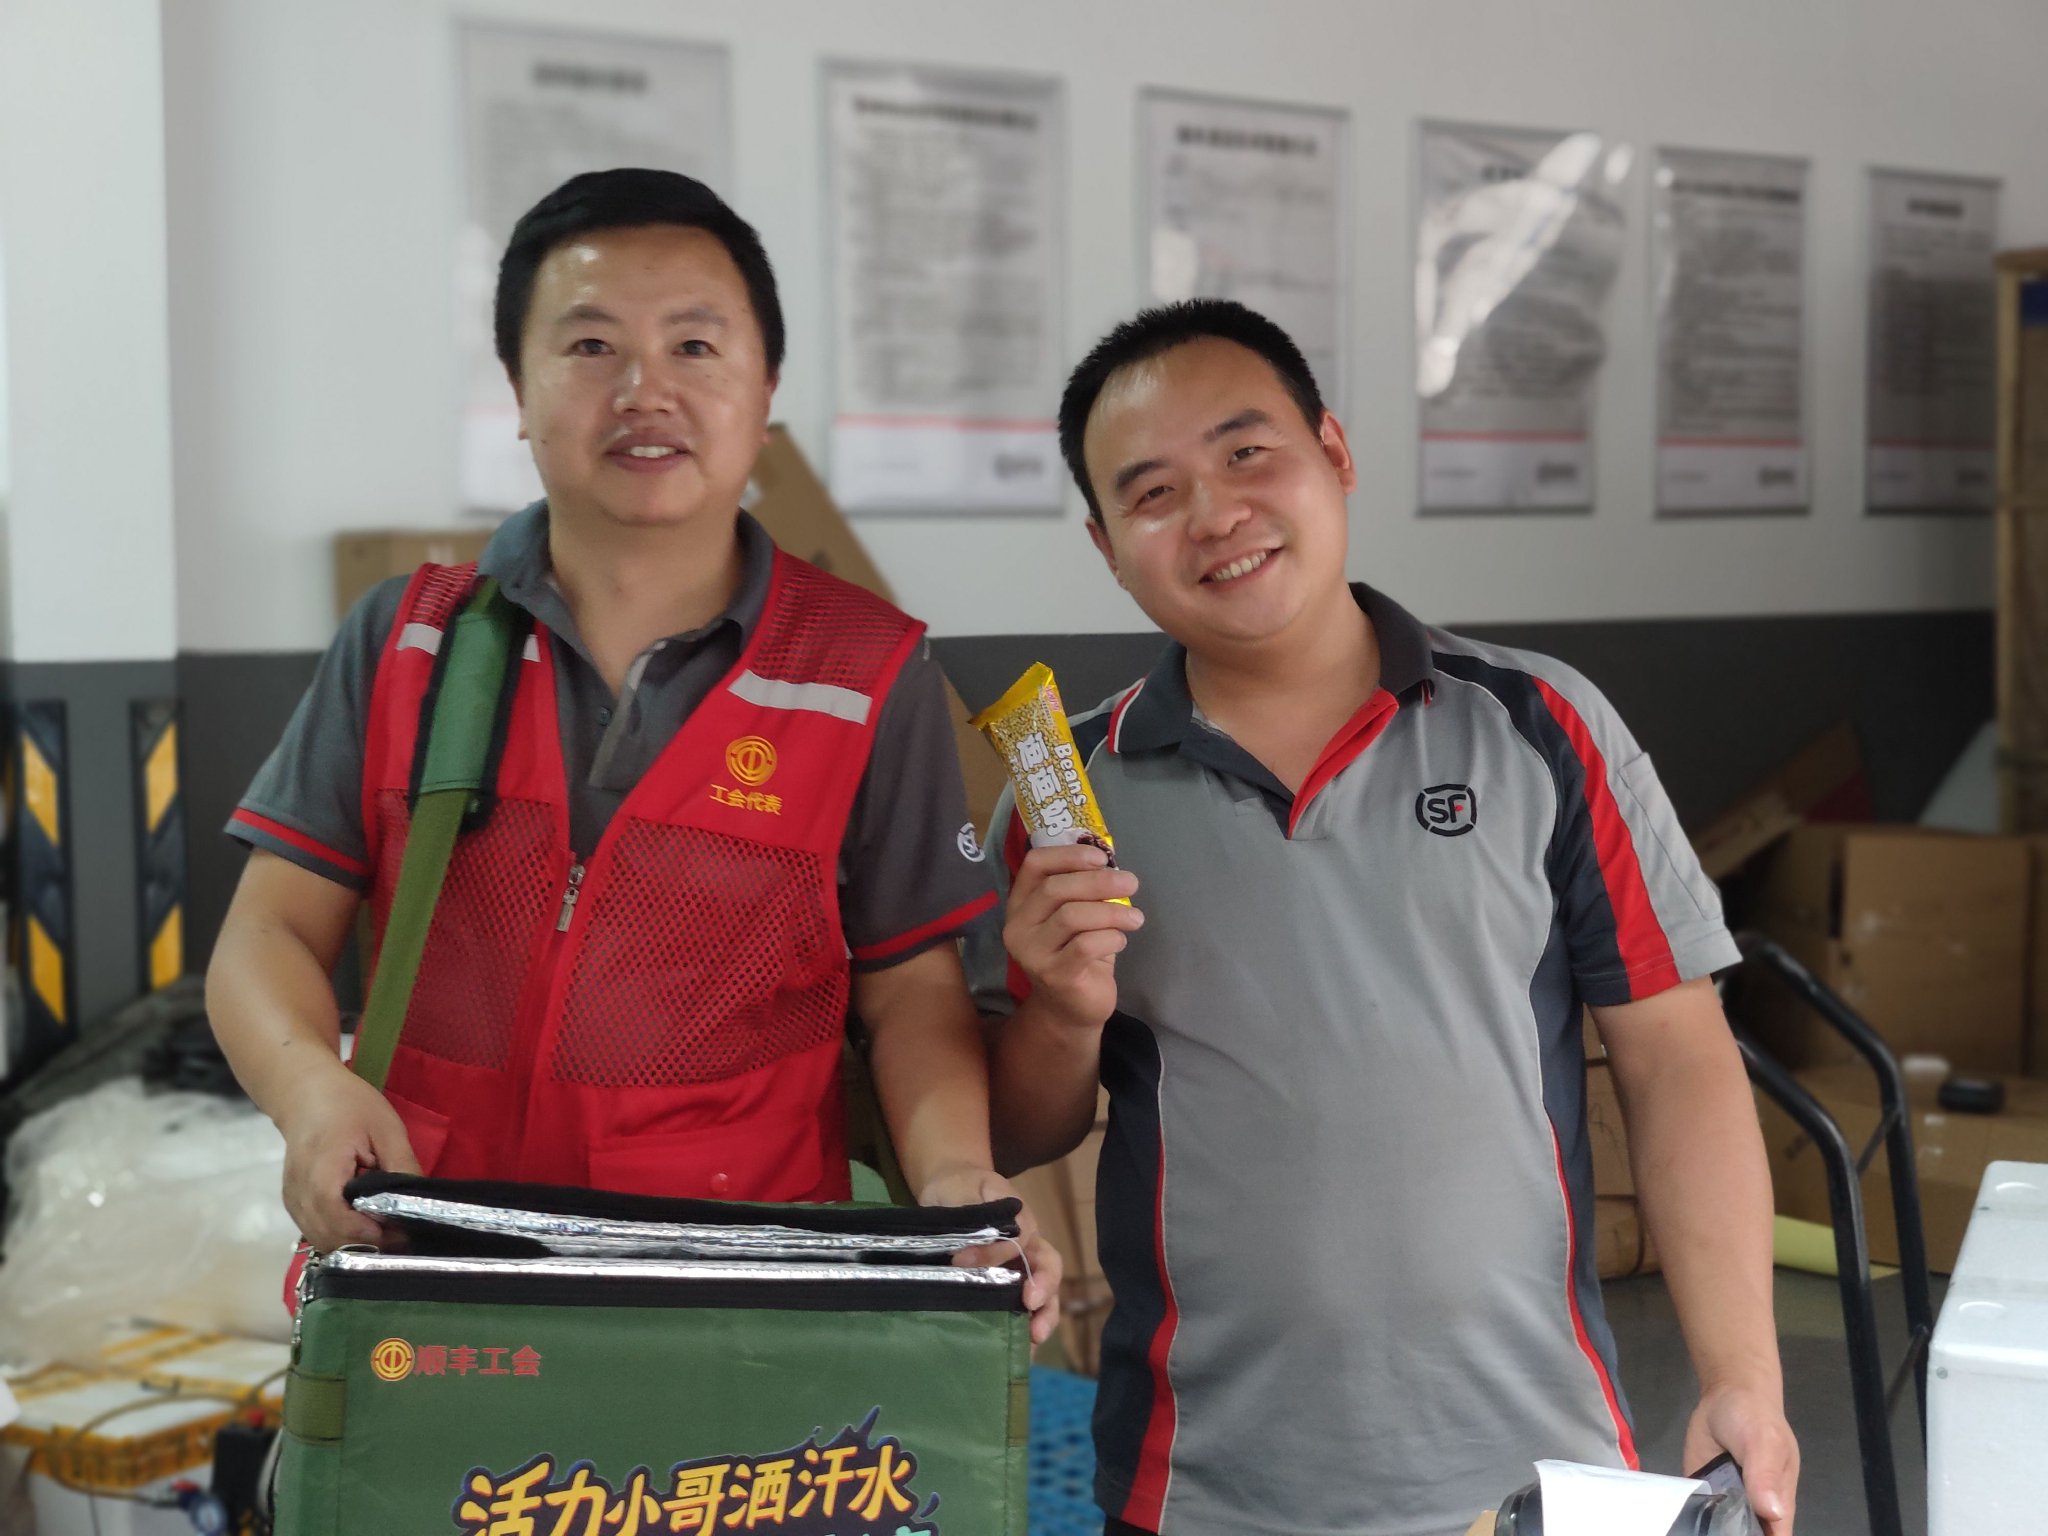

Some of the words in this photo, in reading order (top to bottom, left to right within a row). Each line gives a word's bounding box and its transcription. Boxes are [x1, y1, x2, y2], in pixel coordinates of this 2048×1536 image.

[1016, 731, 1074, 837] 逗逗奶
[1054, 743, 1087, 806] Beans
[709, 784, 783, 816] 工会代表
[1427, 794, 1467, 823] SF
[414, 1344, 542, 1377] 顺丰工会
[459, 1445, 912, 1536] 活力小哥洒汗水
